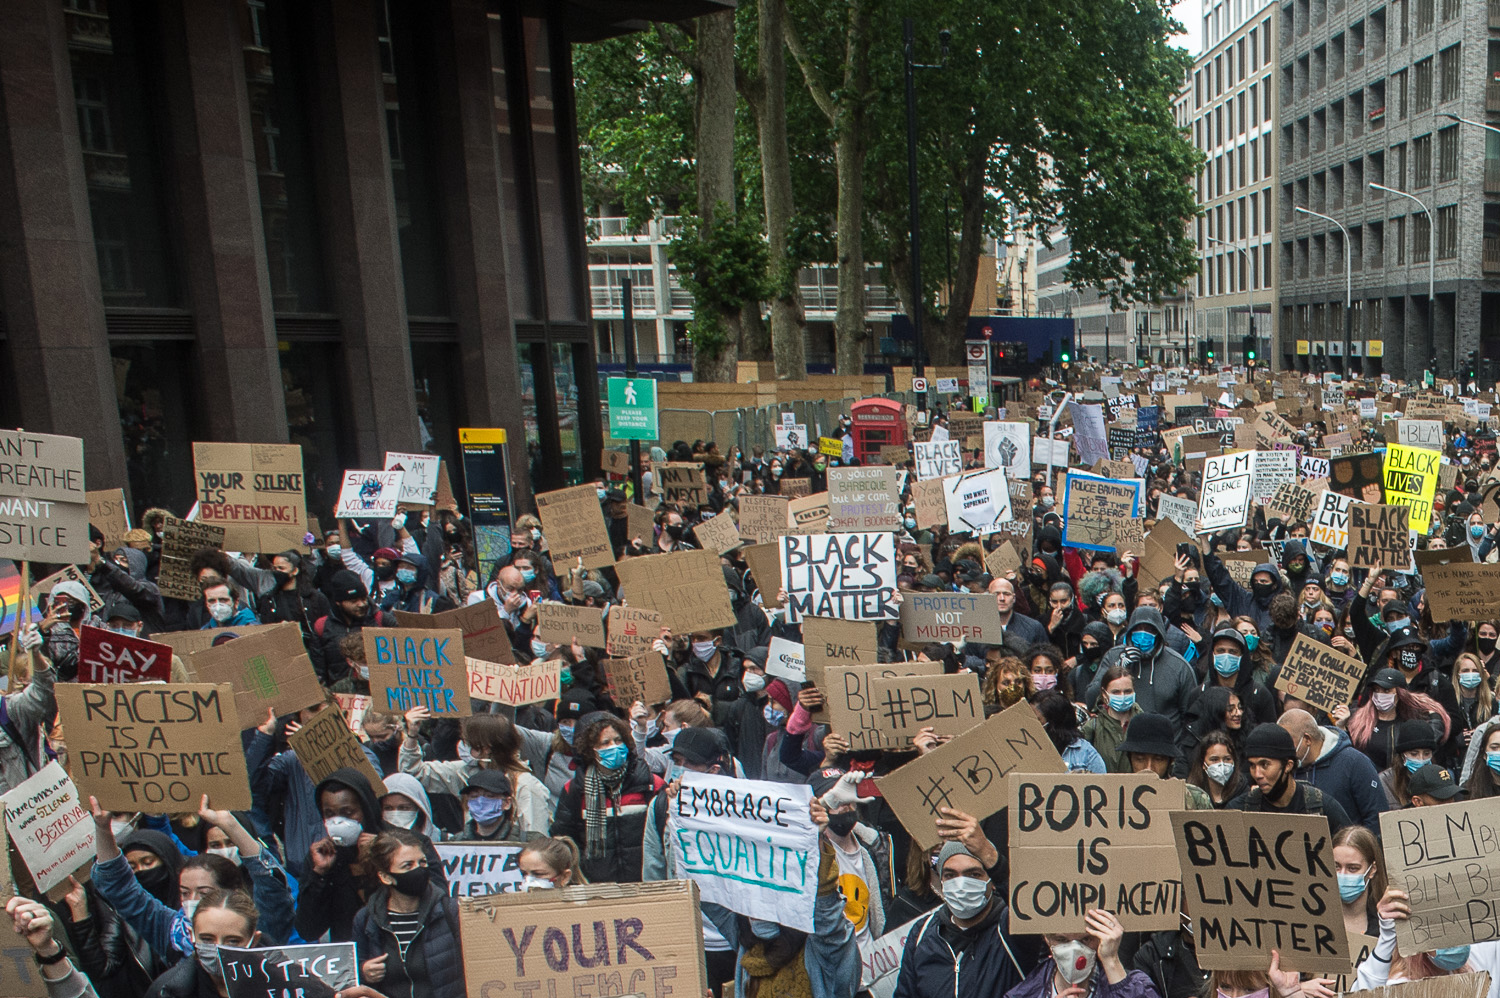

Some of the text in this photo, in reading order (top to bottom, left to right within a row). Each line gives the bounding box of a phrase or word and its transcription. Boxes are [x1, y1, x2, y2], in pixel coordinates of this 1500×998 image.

[916, 442, 959, 461] BLACK
[1389, 448, 1438, 475] BLACK
[847, 469, 883, 481] you can
[917, 459, 961, 477] LIVES
[1206, 453, 1249, 480] BLM
[200, 472, 302, 492] YOUR SILENCE
[348, 474, 397, 486] SILENCE
[1206, 479, 1242, 496] SILENCE
[1387, 471, 1424, 496] LIVES
[200, 488, 226, 505] IS
[345, 499, 395, 511] VIOLENCE
[832, 493, 866, 503] but we
[963, 496, 990, 510] SUPREMACY
[964, 488, 988, 501] END WHITE
[1206, 497, 1215, 508] IS
[201, 504, 298, 522] DEAFENING!
[799, 510, 826, 521] IKEA
[832, 516, 860, 528] OKAY
[1202, 505, 1244, 520] VIOLENCE
[1353, 507, 1406, 530] BLACK
[1361, 528, 1408, 547] LIVES
[785, 535, 889, 568] BLACK
[1354, 549, 1411, 569] MATTER
[786, 563, 883, 593] LIVES
[789, 587, 899, 622] MATTER
[913, 596, 977, 611] PROTECT
[615, 610, 660, 623] SILENCE
[626, 622, 637, 630] IS
[935, 611, 964, 625] NOT
[609, 635, 658, 644] VIOLENCE
[916, 625, 983, 639] MURDER
[99, 641, 157, 673] SAY
[375, 636, 453, 666] BLACK
[1294, 641, 1362, 681] HOW ALL
[398, 669, 444, 689] LIVES
[500, 670, 557, 704] NATION
[1280, 666, 1327, 695] IF BLACK
[1317, 668, 1350, 692] MATTER
[82, 689, 223, 723] RACISM
[387, 687, 459, 713] MATTER
[882, 688, 975, 730] #BLM
[106, 725, 169, 750] IS A
[81, 751, 231, 778] PANDEMIC
[120, 780, 192, 803] TOO
[677, 785, 793, 828] EMBRACE
[1018, 782, 1158, 832] BORIS
[1183, 820, 1334, 878] BLACK
[1398, 811, 1486, 868] BLM
[1078, 838, 1111, 876] IS
[1012, 879, 1183, 919] COMPLACENT
[1199, 877, 1329, 917] LIVES
[502, 916, 656, 977] YOUR
[1199, 916, 1339, 955] MATTER
[227, 957, 342, 984] JUSTICE
